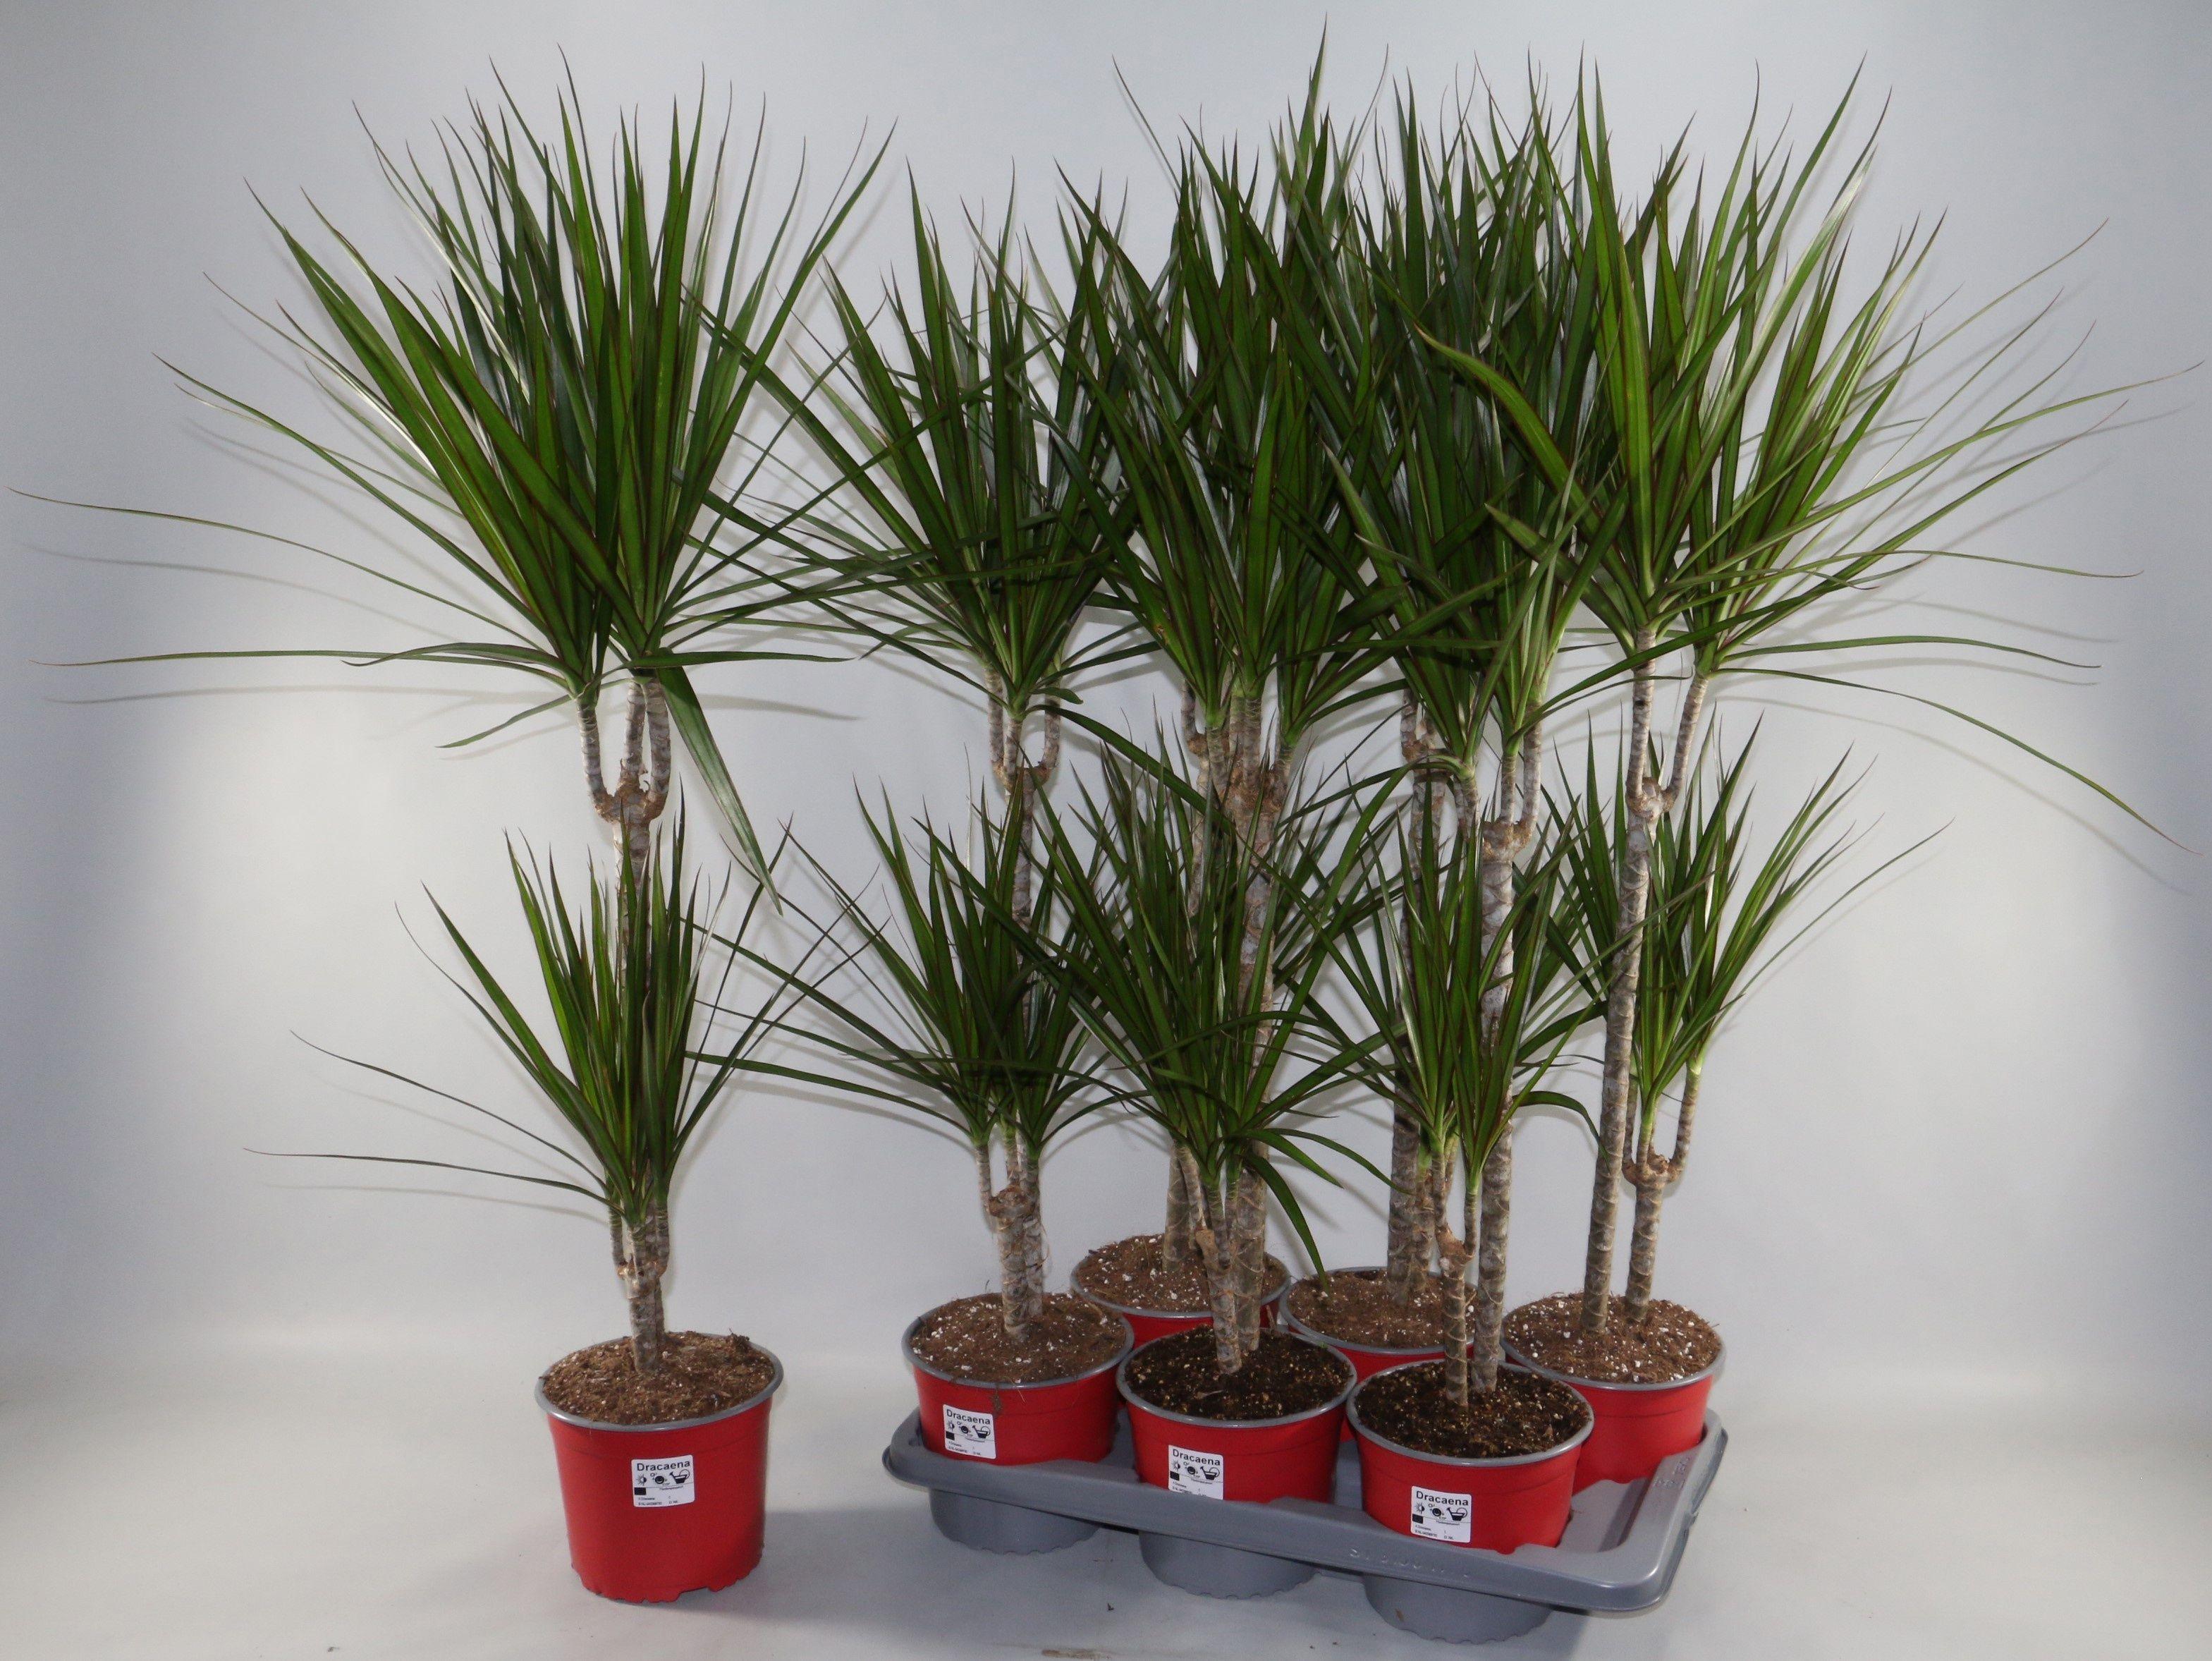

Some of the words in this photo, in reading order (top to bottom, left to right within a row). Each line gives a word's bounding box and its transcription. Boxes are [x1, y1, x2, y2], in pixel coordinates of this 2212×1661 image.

[946, 1408, 991, 1425] Dracaena
[1172, 1448, 1221, 1466] Dracaena
[637, 1461, 690, 1471] Dracaena
[1416, 1490, 1469, 1506] Dracaena
